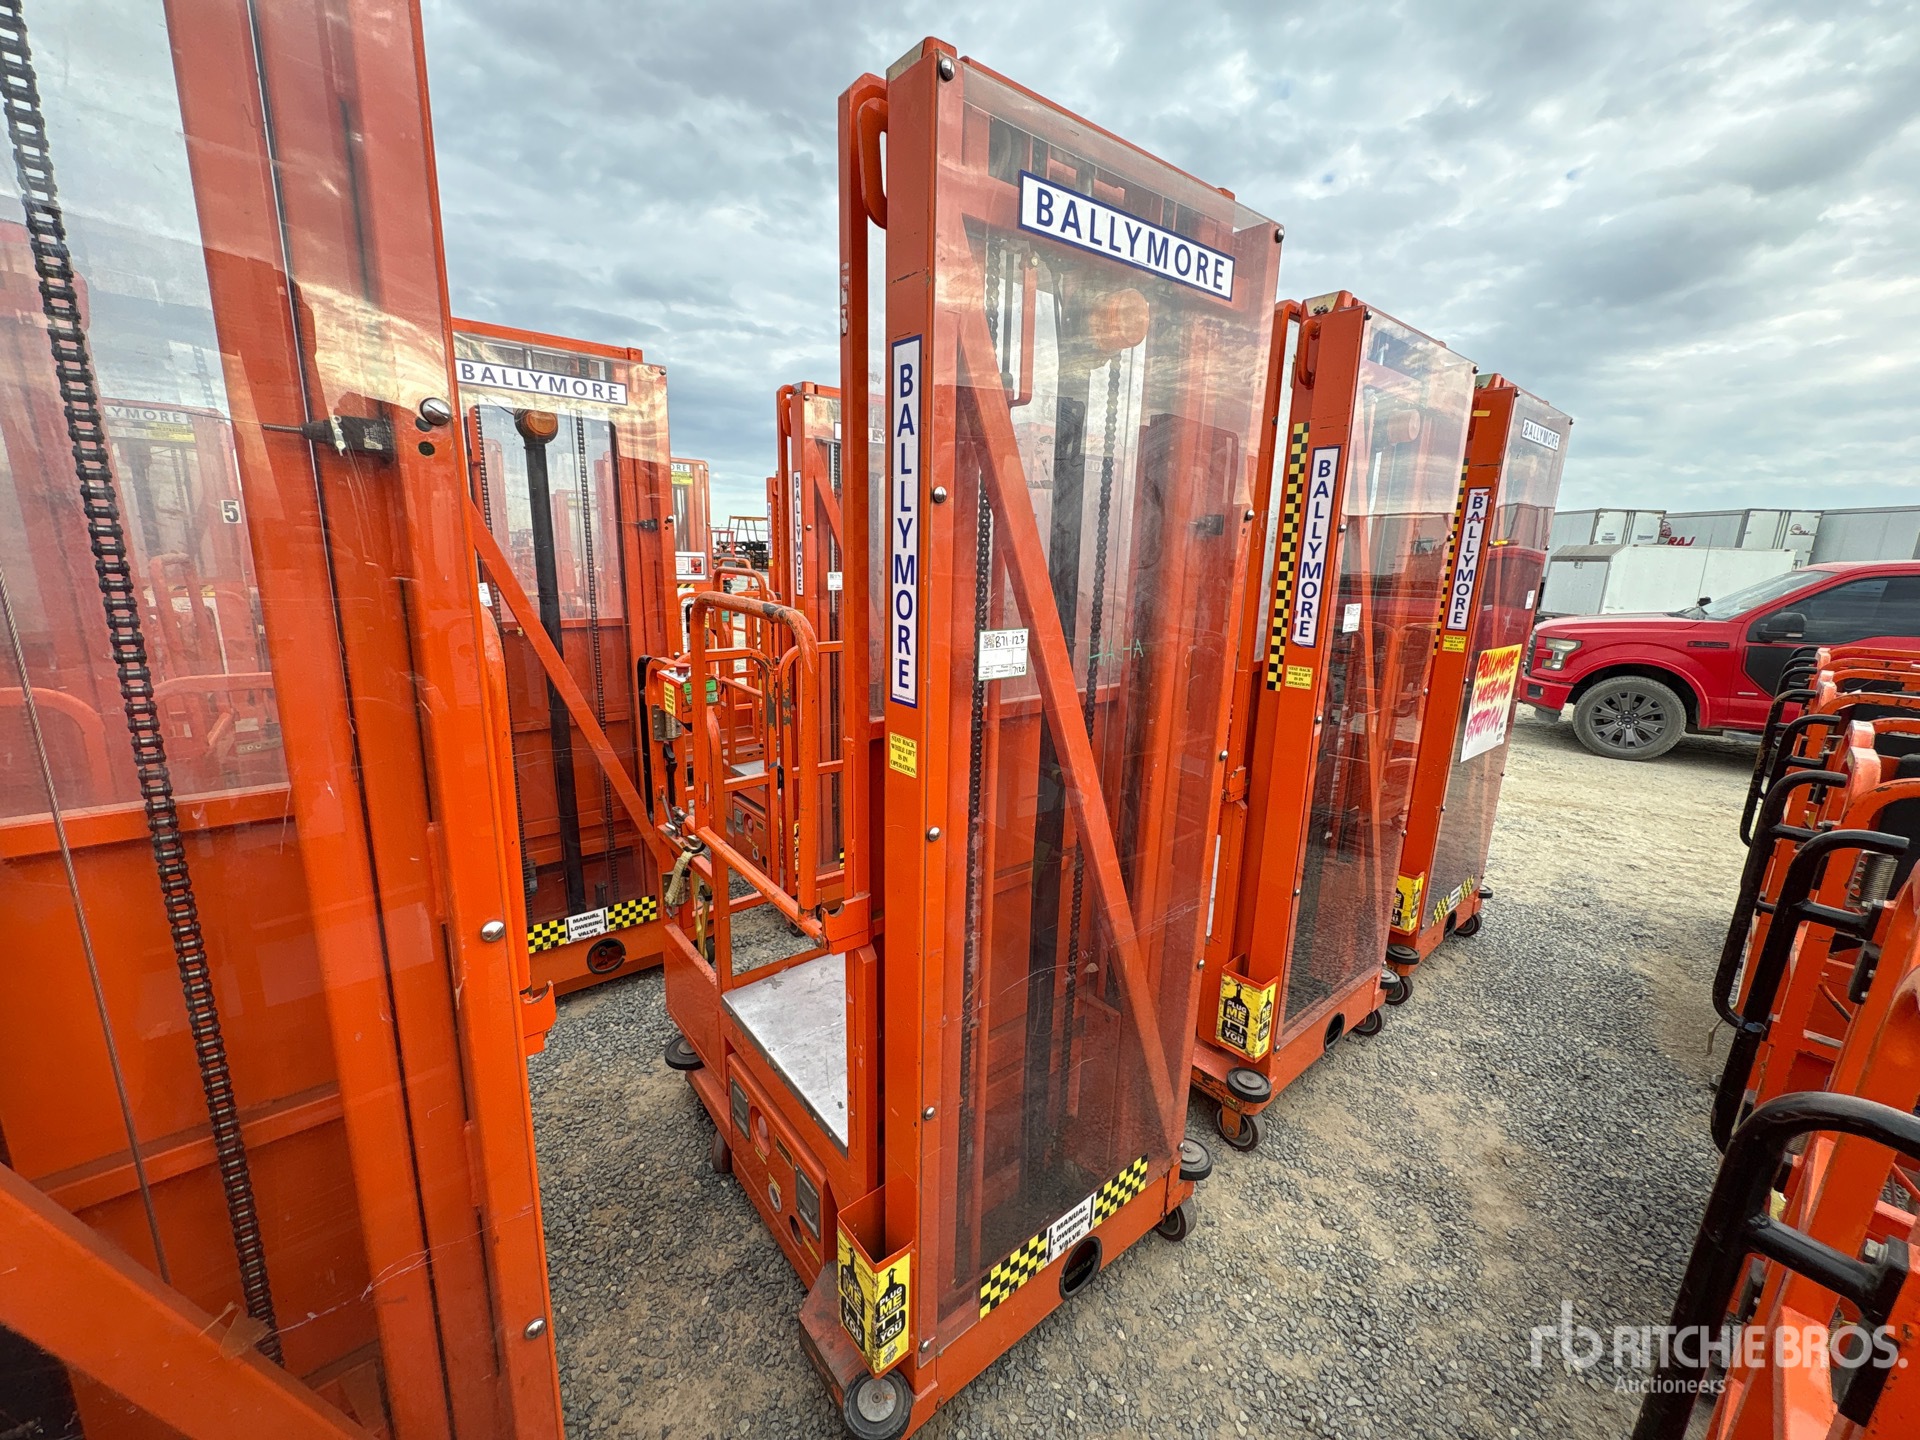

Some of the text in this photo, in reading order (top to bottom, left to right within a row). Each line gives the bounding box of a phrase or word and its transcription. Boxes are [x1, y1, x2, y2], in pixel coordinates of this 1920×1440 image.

[1036, 187, 1225, 290] BALLYMORE
[461, 363, 618, 401] BALLYMORE
[223, 501, 239, 523] 5
[895, 363, 915, 689] BALLYMORE
[1299, 459, 1331, 637] BALLYMORE
[1667, 536, 1696, 547] RAJ
[1453, 496, 1483, 624] BALLYMORE
[891, 743, 915, 757] WHILE LIFT
[892, 735, 915, 748] STAY BACK
[890, 759, 915, 774] OPERATION
[570, 920, 603, 932] LOWERING
[572, 912, 600, 924] MANUAL
[578, 928, 598, 937] VALVE
[1226, 1006, 1246, 1022] ME
[1227, 1000, 1247, 1013] PLUG
[1225, 1030, 1244, 1044] YOU
[1056, 1204, 1087, 1232] MANUAL
[1052, 1213, 1089, 1246] LOWERING
[1059, 1229, 1081, 1250] VALVE
[880, 1286, 903, 1306] PLUG
[880, 1295, 903, 1317] ME
[844, 1312, 862, 1341] YOU
[880, 1321, 902, 1341] YOU
